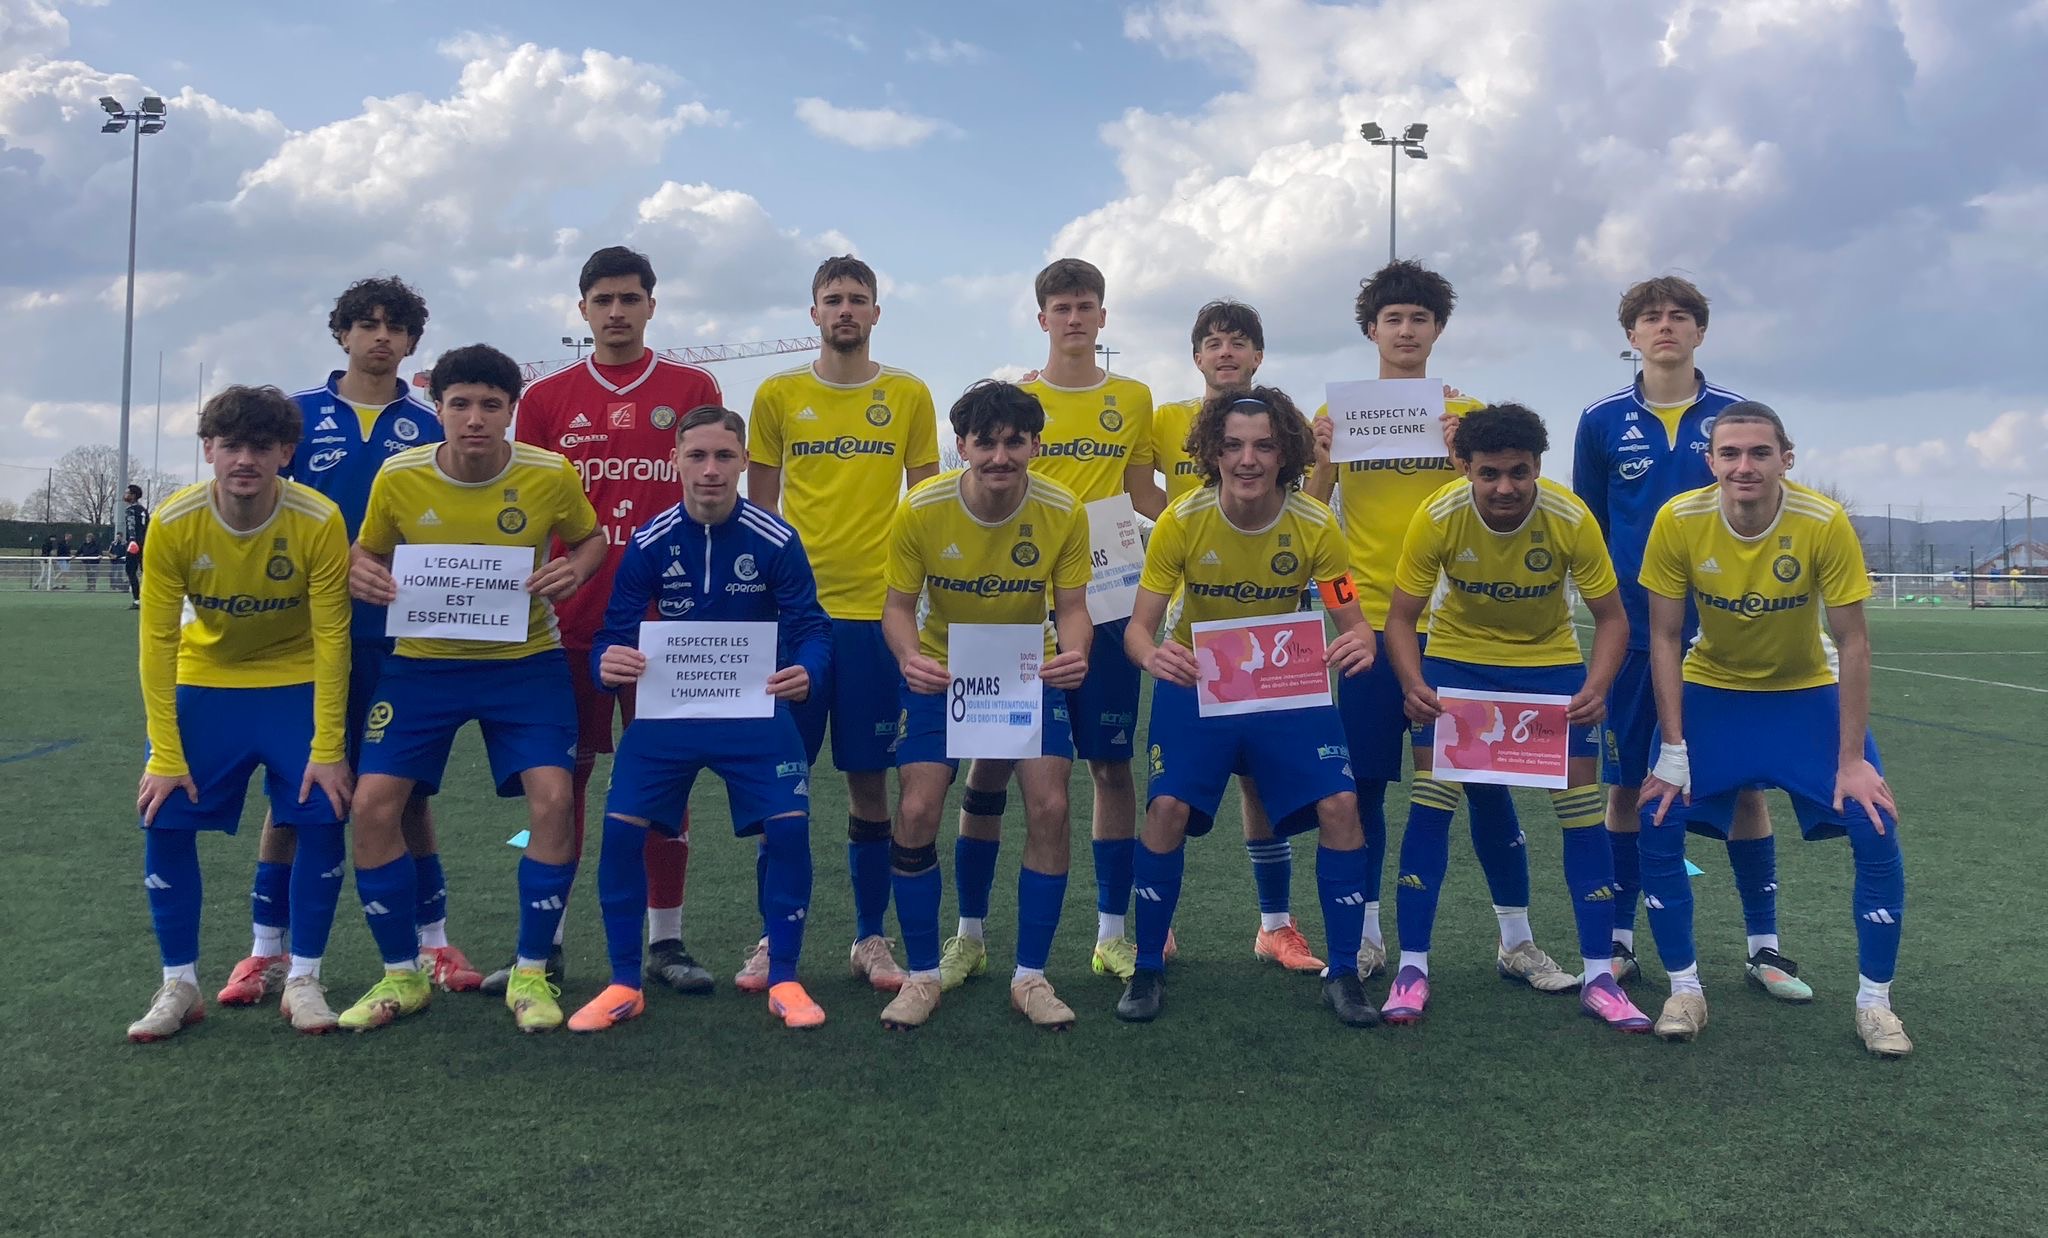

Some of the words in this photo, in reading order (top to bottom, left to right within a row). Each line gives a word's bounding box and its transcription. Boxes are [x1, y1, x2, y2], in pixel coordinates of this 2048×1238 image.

[1345, 411, 1357, 421] LE
[1360, 408, 1406, 420] RESPECT
[1408, 407, 1428, 418] N'A
[1625, 411, 1639, 422] AM
[1349, 426, 1370, 437] PAS
[1373, 425, 1387, 435] DE
[1389, 423, 1426, 434] GENRE
[1622, 457, 1654, 473] PVP
[669, 544, 681, 556] YC
[424, 557, 503, 571] L'EGALITE
[403, 574, 520, 591] HOMME-FEMME
[1333, 576, 1354, 605] C
[446, 594, 475, 606] EST
[407, 610, 510, 626] ESSENTIELLE
[667, 637, 728, 648] RESPECTER
[731, 637, 749, 647] LES
[1271, 629, 1294, 668] 8
[665, 654, 717, 666] FEMMES,
[720, 654, 750, 664] C'EST
[676, 671, 737, 681] RESPECTER
[671, 687, 742, 698] L'HUMANITE
[951, 677, 966, 723] 8
[966, 676, 1000, 696] MARS
[1511, 709, 1539, 743] 8
